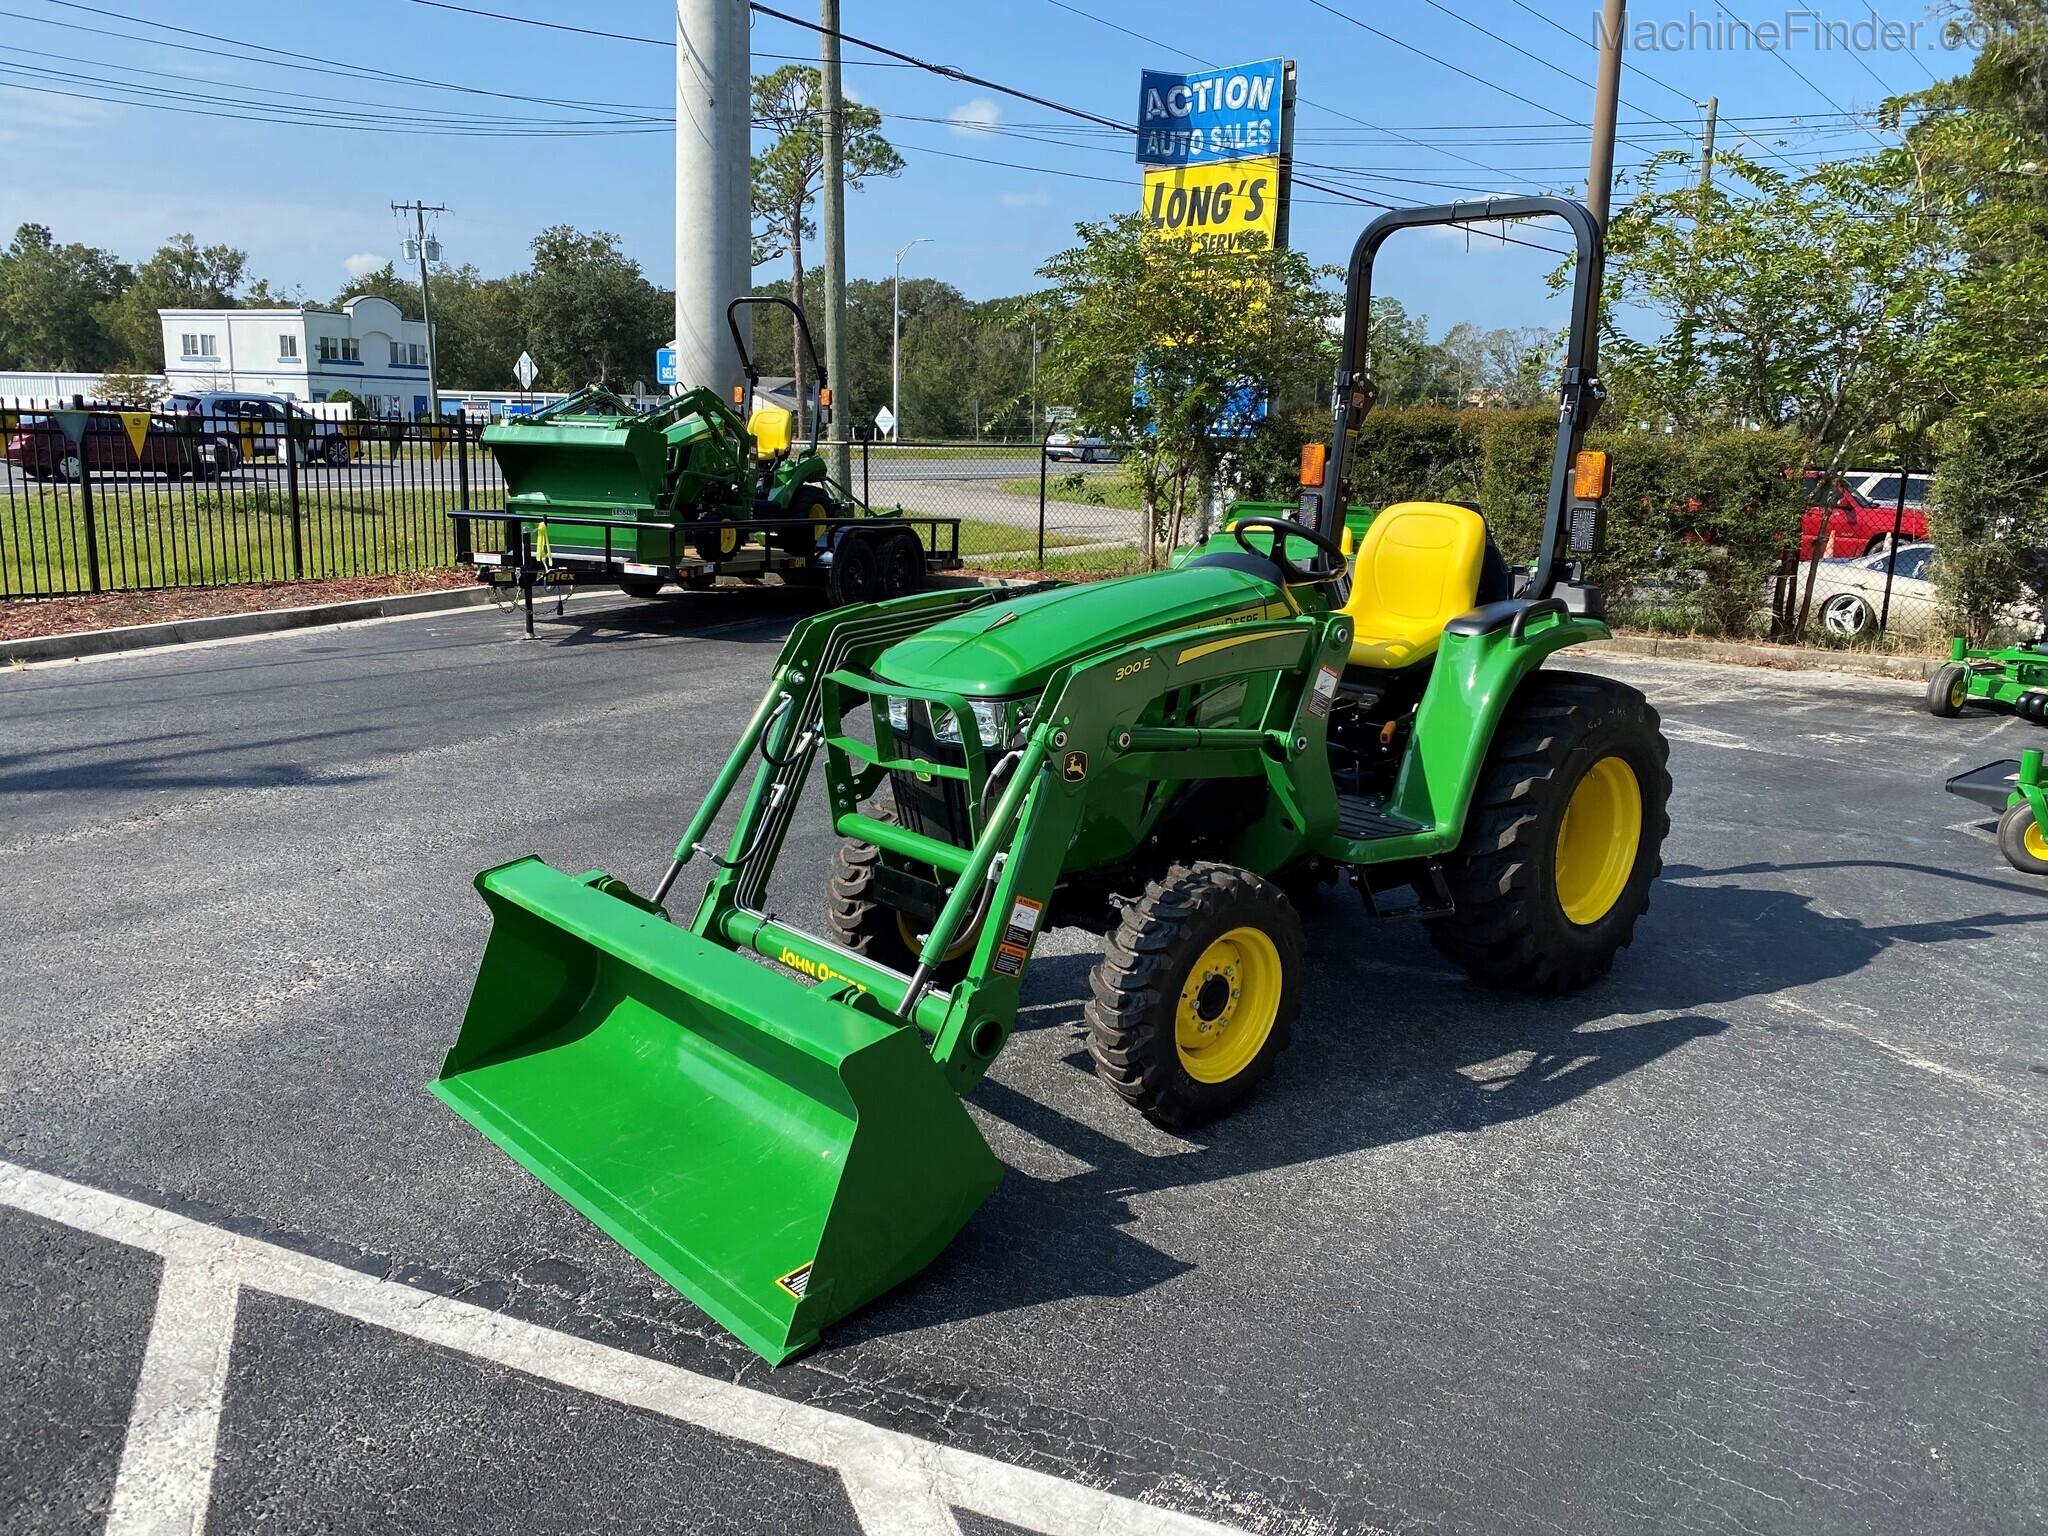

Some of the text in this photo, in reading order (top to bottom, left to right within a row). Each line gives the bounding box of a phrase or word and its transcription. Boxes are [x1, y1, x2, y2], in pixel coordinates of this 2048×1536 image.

[1145, 75, 1275, 122] ACTION
[1146, 119, 1272, 157] AUTO SALES
[1151, 178, 1268, 230] LONG'S
[778, 946, 816, 977] JOHN
